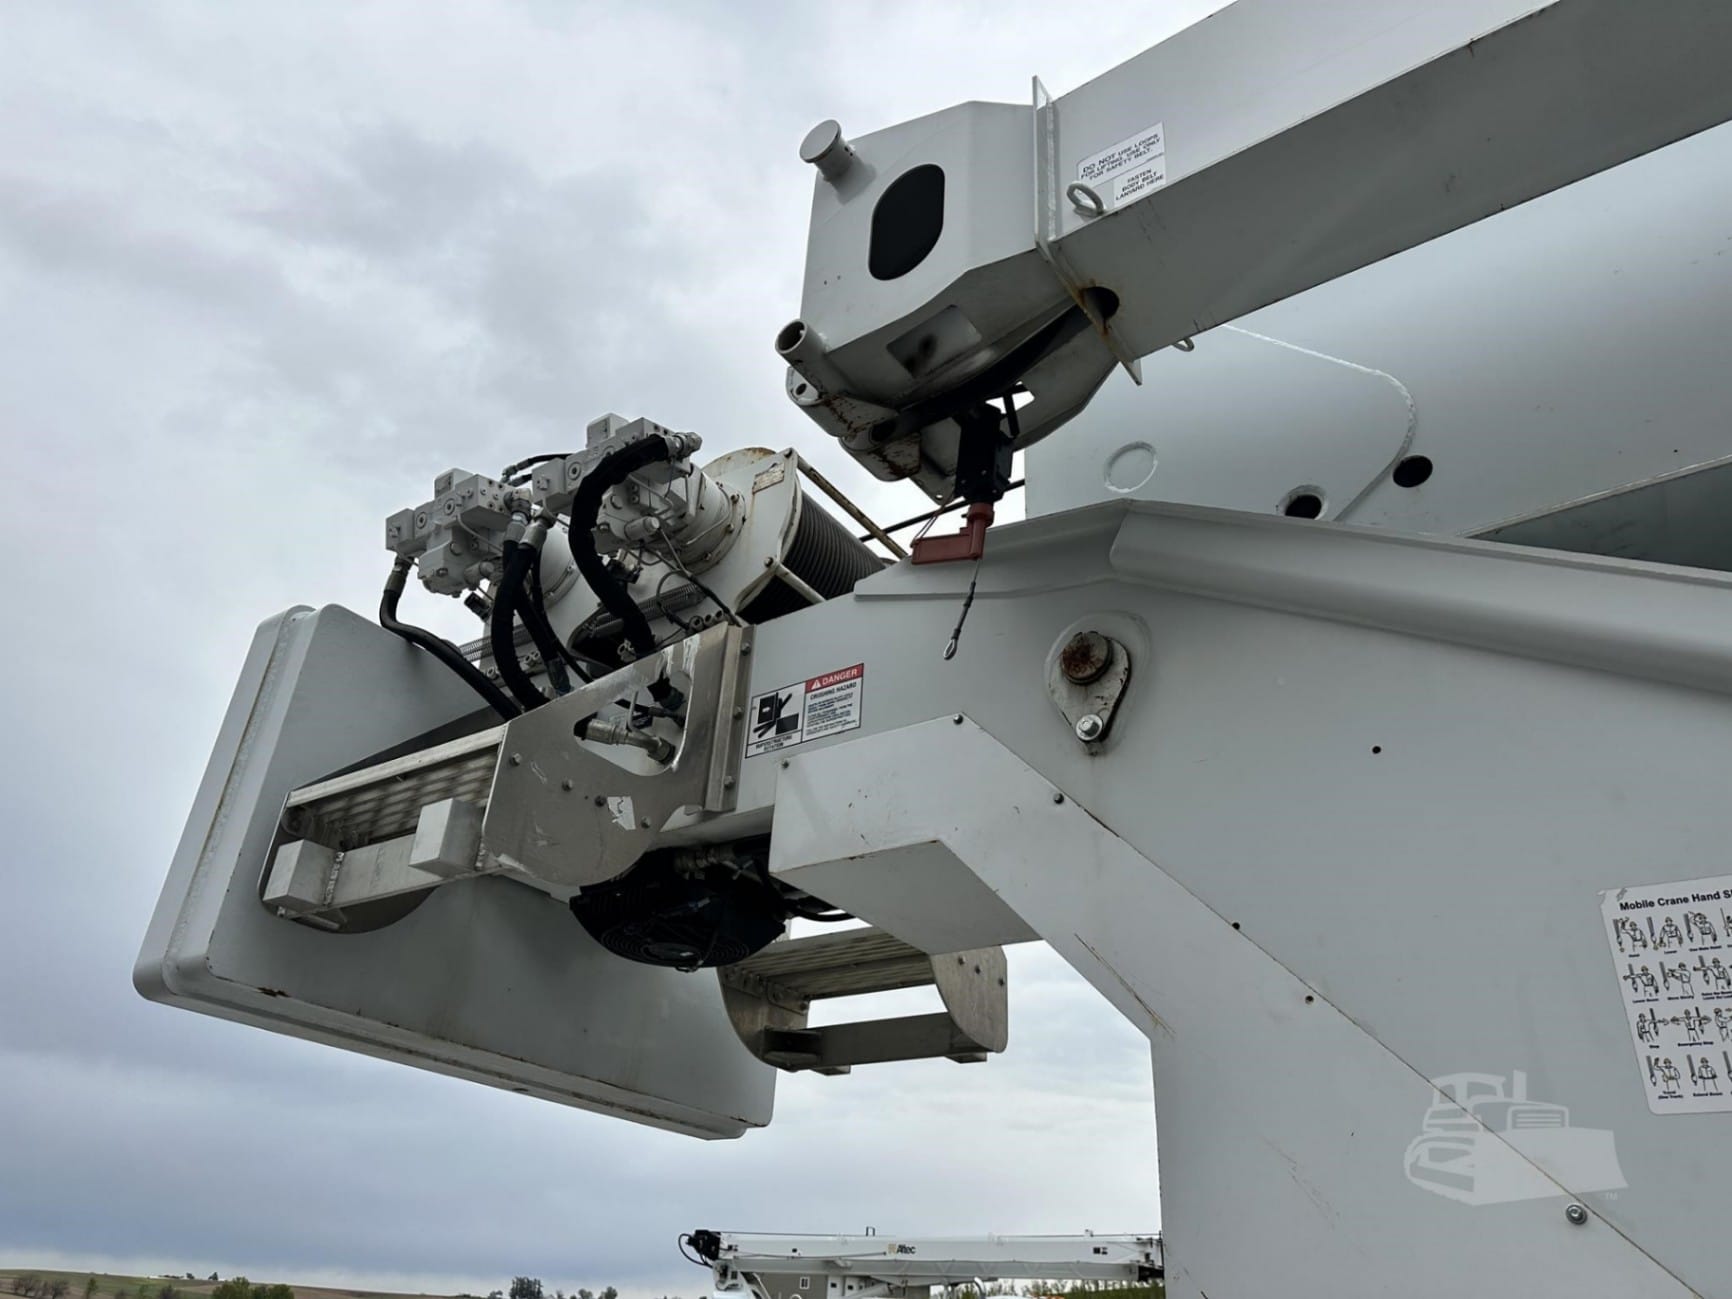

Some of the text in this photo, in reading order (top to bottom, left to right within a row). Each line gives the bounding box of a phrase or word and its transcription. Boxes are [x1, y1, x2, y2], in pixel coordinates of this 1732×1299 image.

[1081, 170, 1095, 180] FOR
[1126, 147, 1141, 157] USE
[1143, 137, 1160, 149] ONLY
[1083, 133, 1158, 173] DO NOT USE LOOPS
[1089, 171, 1104, 180] FOR
[1106, 158, 1131, 172] SAFETY
[1127, 168, 1152, 183] FASTEN
[1116, 174, 1163, 200] LANYARD HERE
[1122, 171, 1157, 192] BODY BELT
[822, 668, 858, 685] DANGER
[836, 681, 857, 692] HAZARD
[1620, 900, 1655, 911] Mobile
[1657, 896, 1689, 907] Crane
[1691, 891, 1720, 902] Hand
